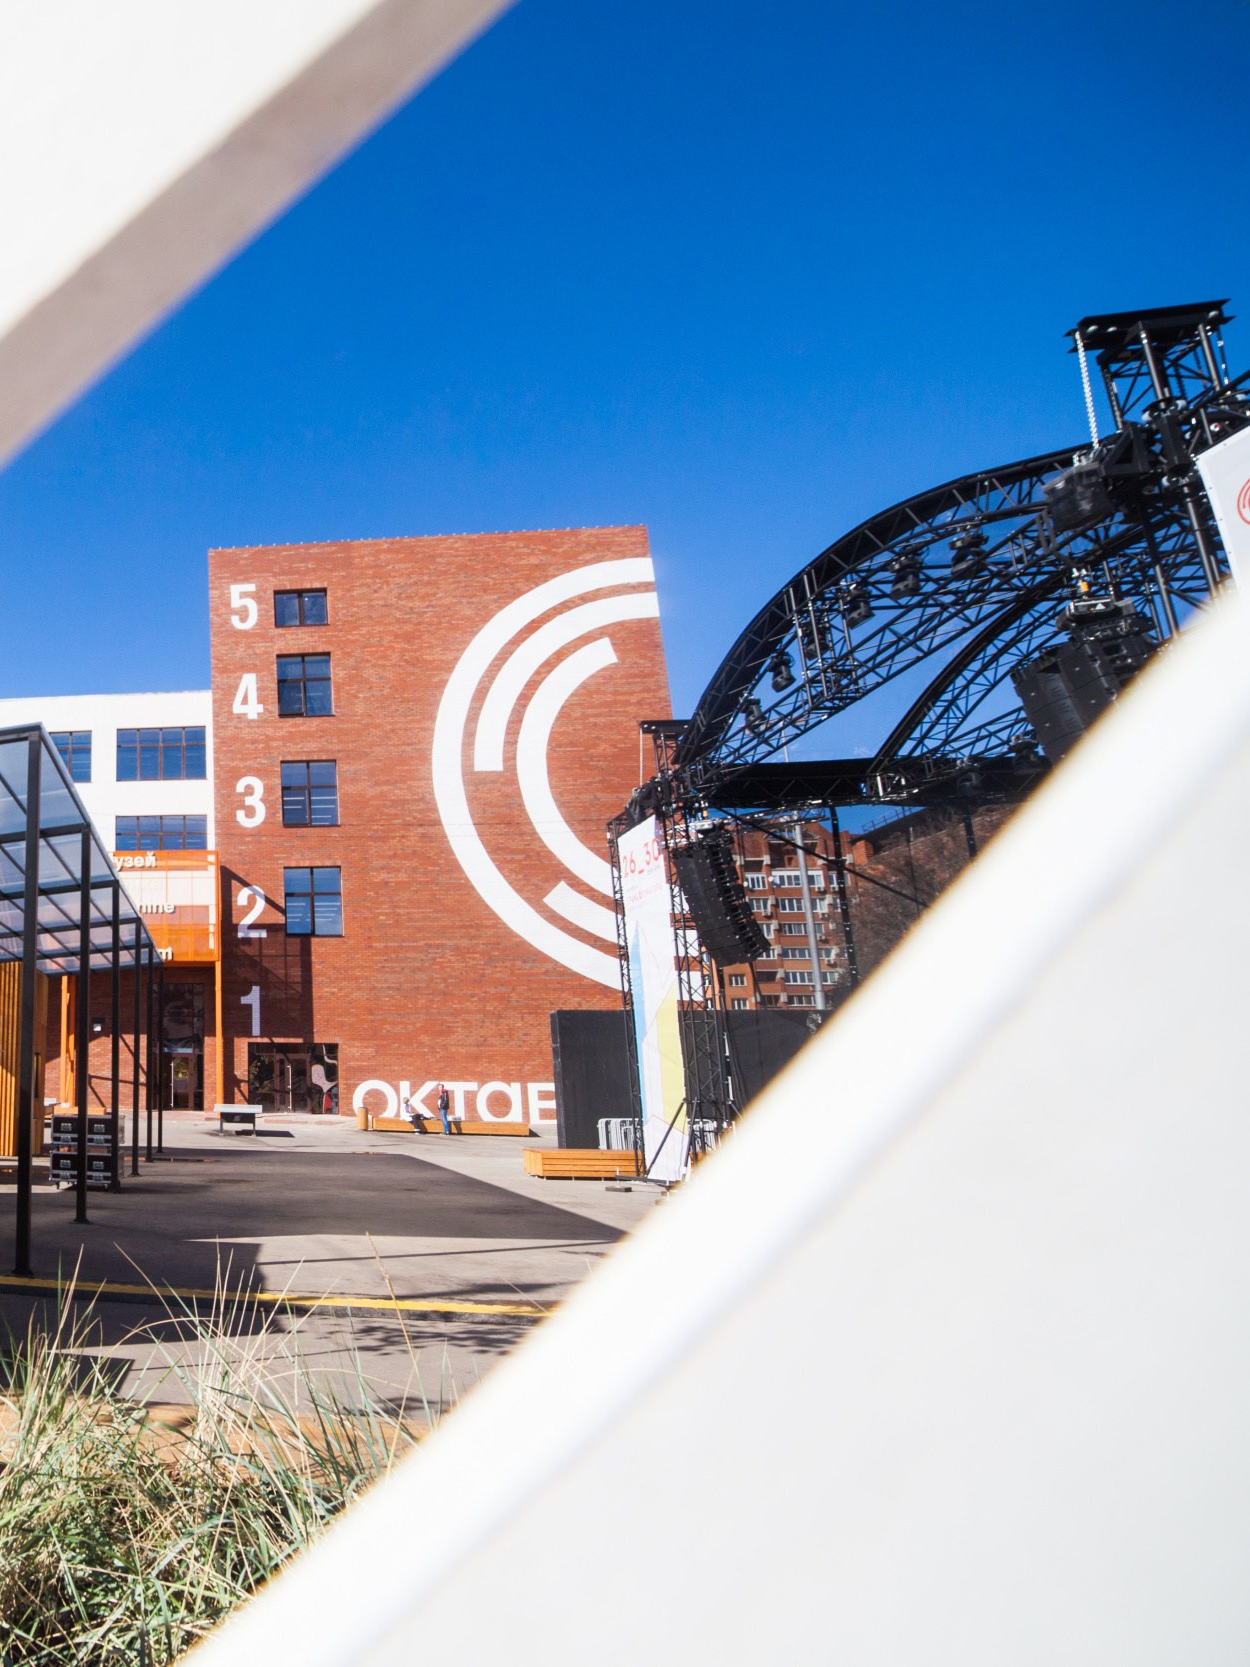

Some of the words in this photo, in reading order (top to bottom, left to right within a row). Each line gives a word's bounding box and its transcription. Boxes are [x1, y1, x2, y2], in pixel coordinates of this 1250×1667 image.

[230, 584, 258, 630] 5
[232, 673, 263, 719] 4
[235, 776, 266, 827] 3
[237, 885, 267, 938] 2
[240, 986, 261, 1036] 1
